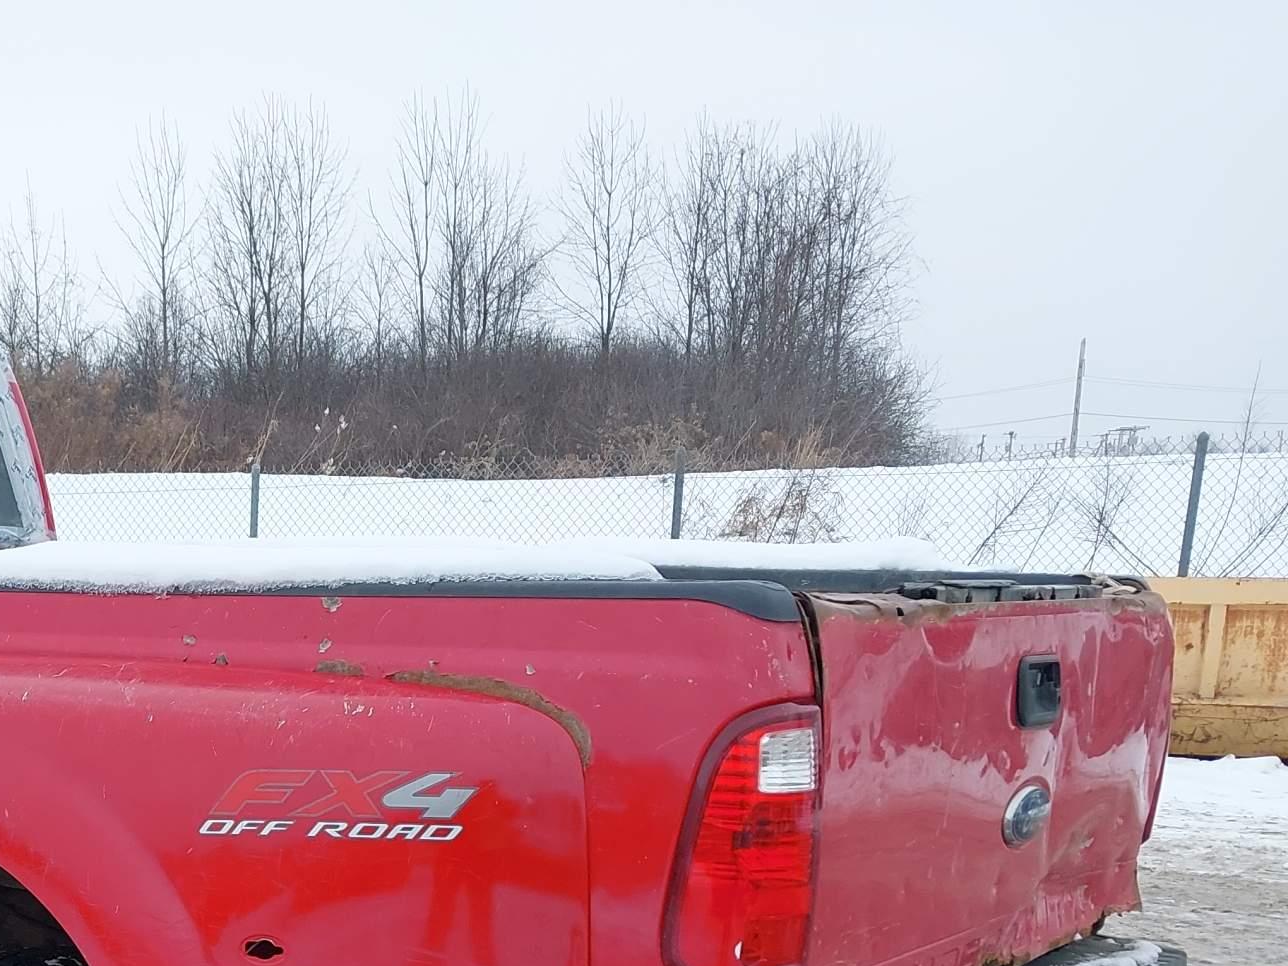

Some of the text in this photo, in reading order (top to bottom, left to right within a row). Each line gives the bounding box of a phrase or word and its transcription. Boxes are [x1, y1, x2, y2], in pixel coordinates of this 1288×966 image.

[209, 769, 479, 819] FX4
[199, 818, 464, 842] OFF ROAD
